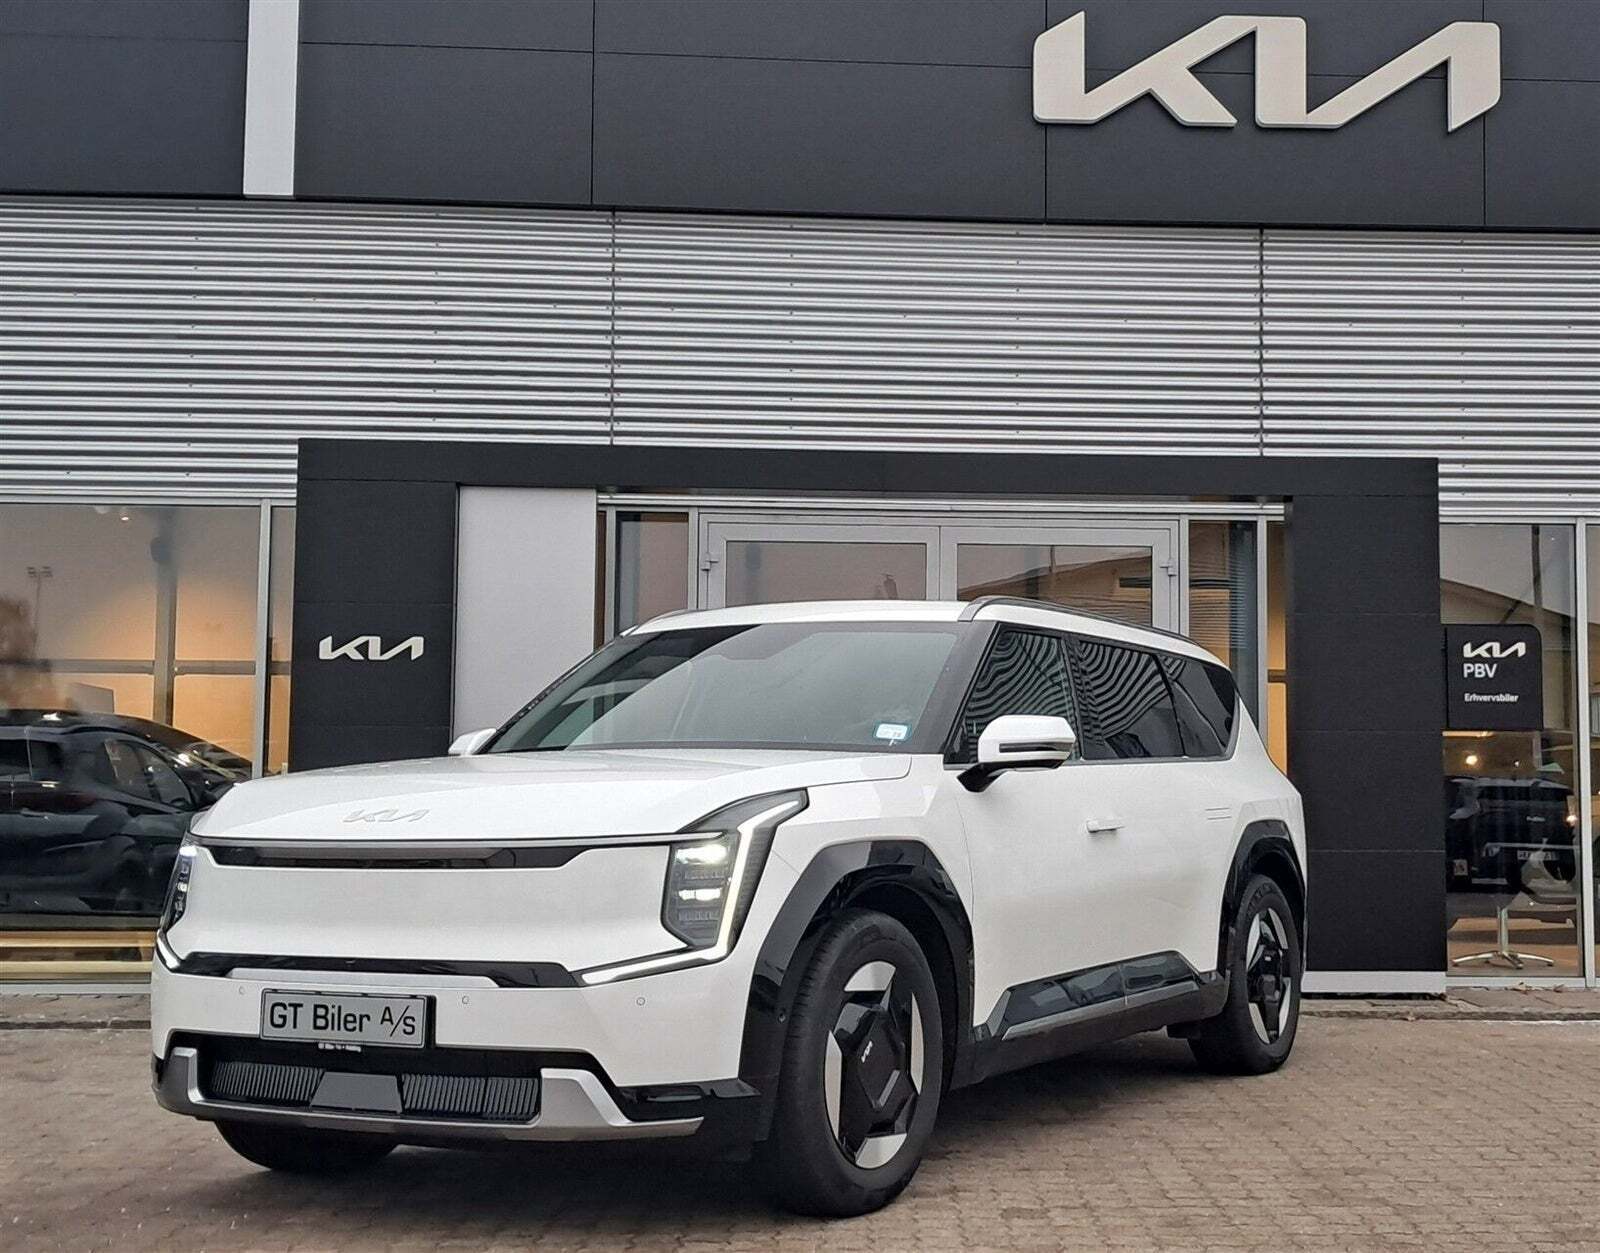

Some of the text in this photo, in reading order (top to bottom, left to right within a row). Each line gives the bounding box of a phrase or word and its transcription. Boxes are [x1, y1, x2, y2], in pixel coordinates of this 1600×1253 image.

[1033, 10, 1501, 133] KIA
[318, 635, 424, 661] KIA
[1462, 641, 1527, 658] KIA
[1463, 663, 1498, 678] PBV
[1464, 692, 1519, 702] Erhvervsbiler
[269, 1001, 416, 1037] GT Biler A/S
